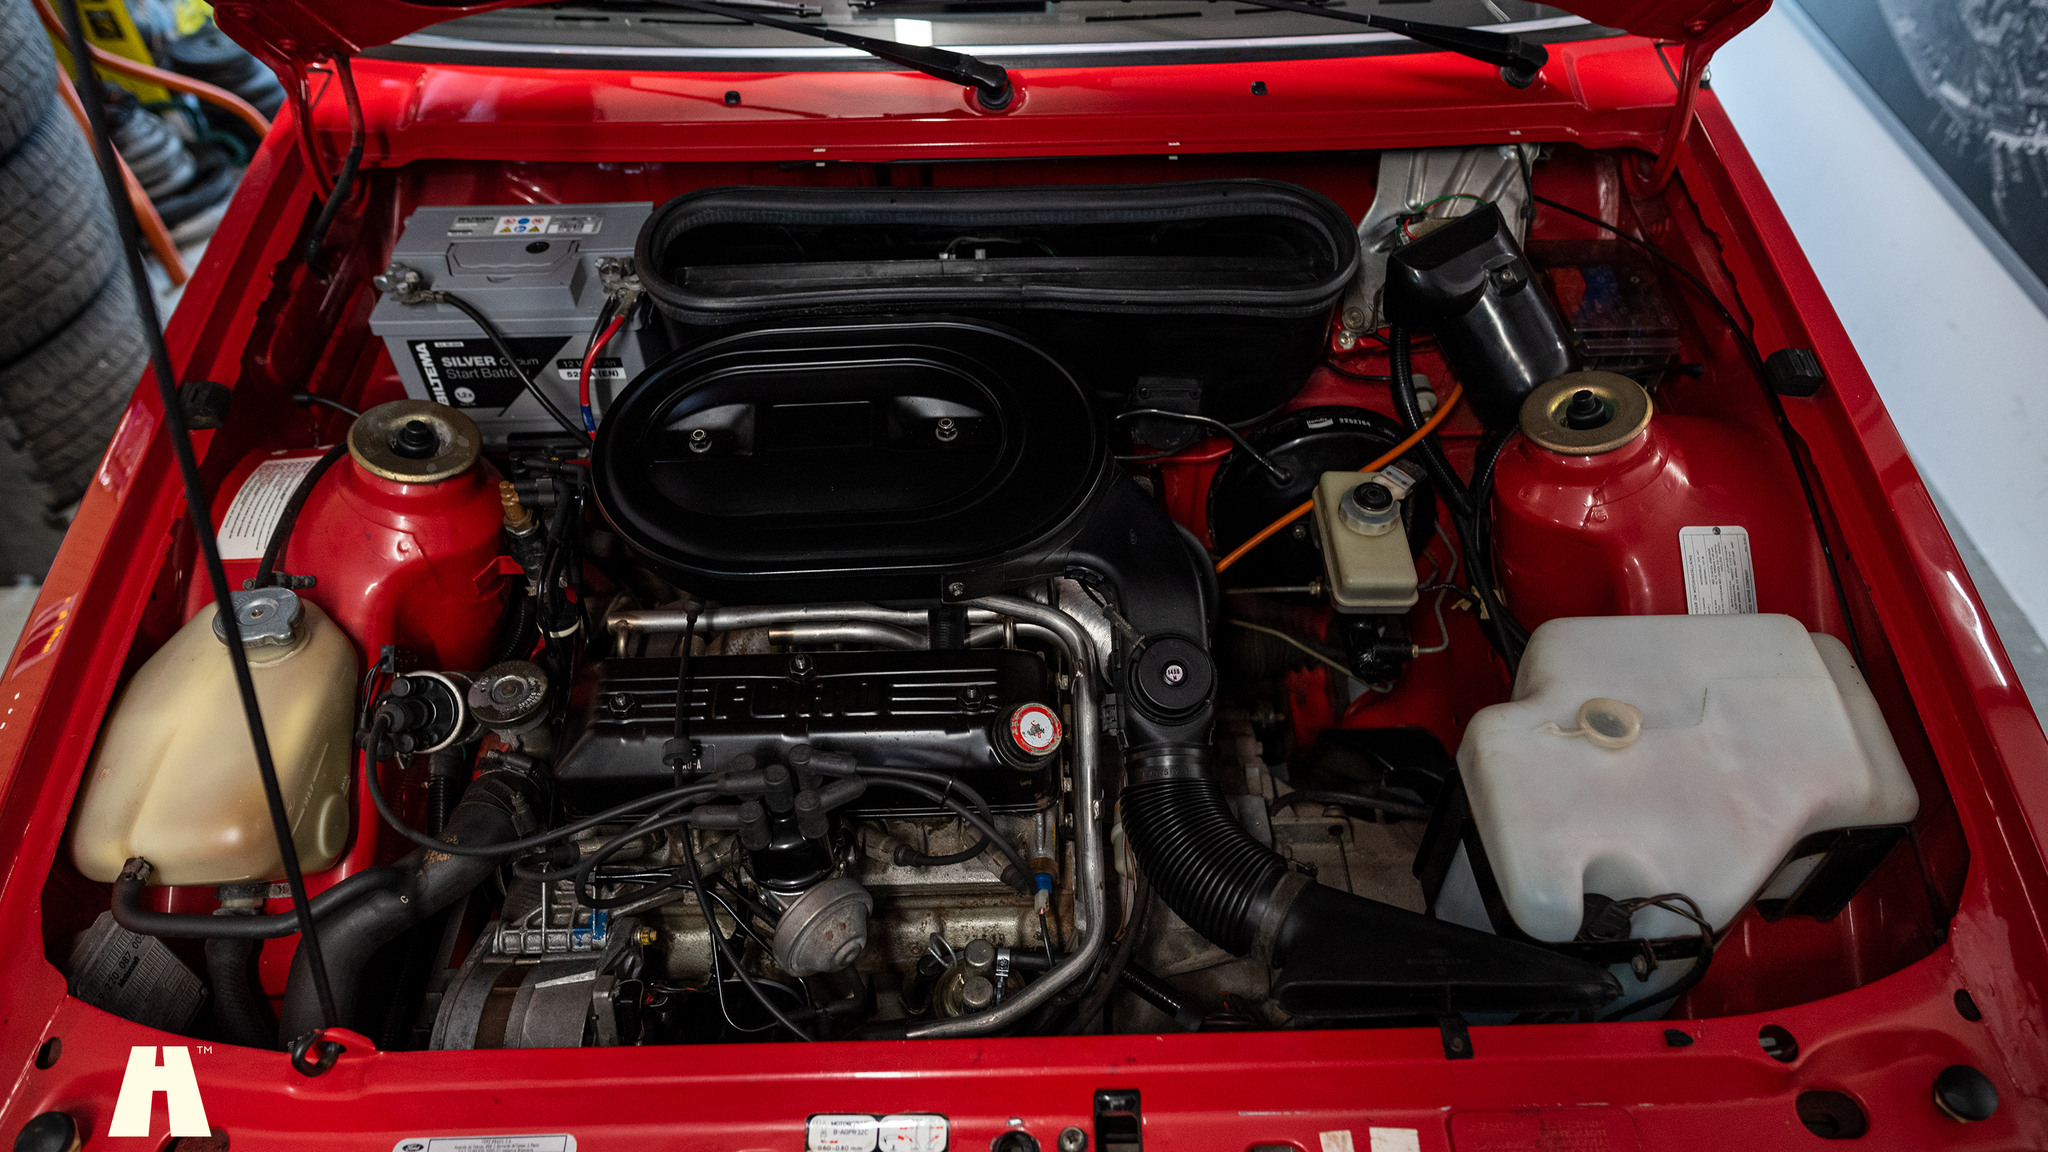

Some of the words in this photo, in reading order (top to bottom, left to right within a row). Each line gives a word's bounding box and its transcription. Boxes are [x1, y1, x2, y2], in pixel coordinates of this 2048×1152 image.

[441, 355, 497, 367] SILVER
[499, 357, 540, 367] Cium
[563, 360, 575, 368] 12
[415, 342, 451, 406] BILTEMA
[446, 368, 480, 380] Start
[480, 367, 530, 380] Batte
[598, 369, 619, 378] (EN)
[104, 972, 119, 992] 220
[118, 950, 132, 970] 087
[117, 956, 141, 989] Motorcraft
